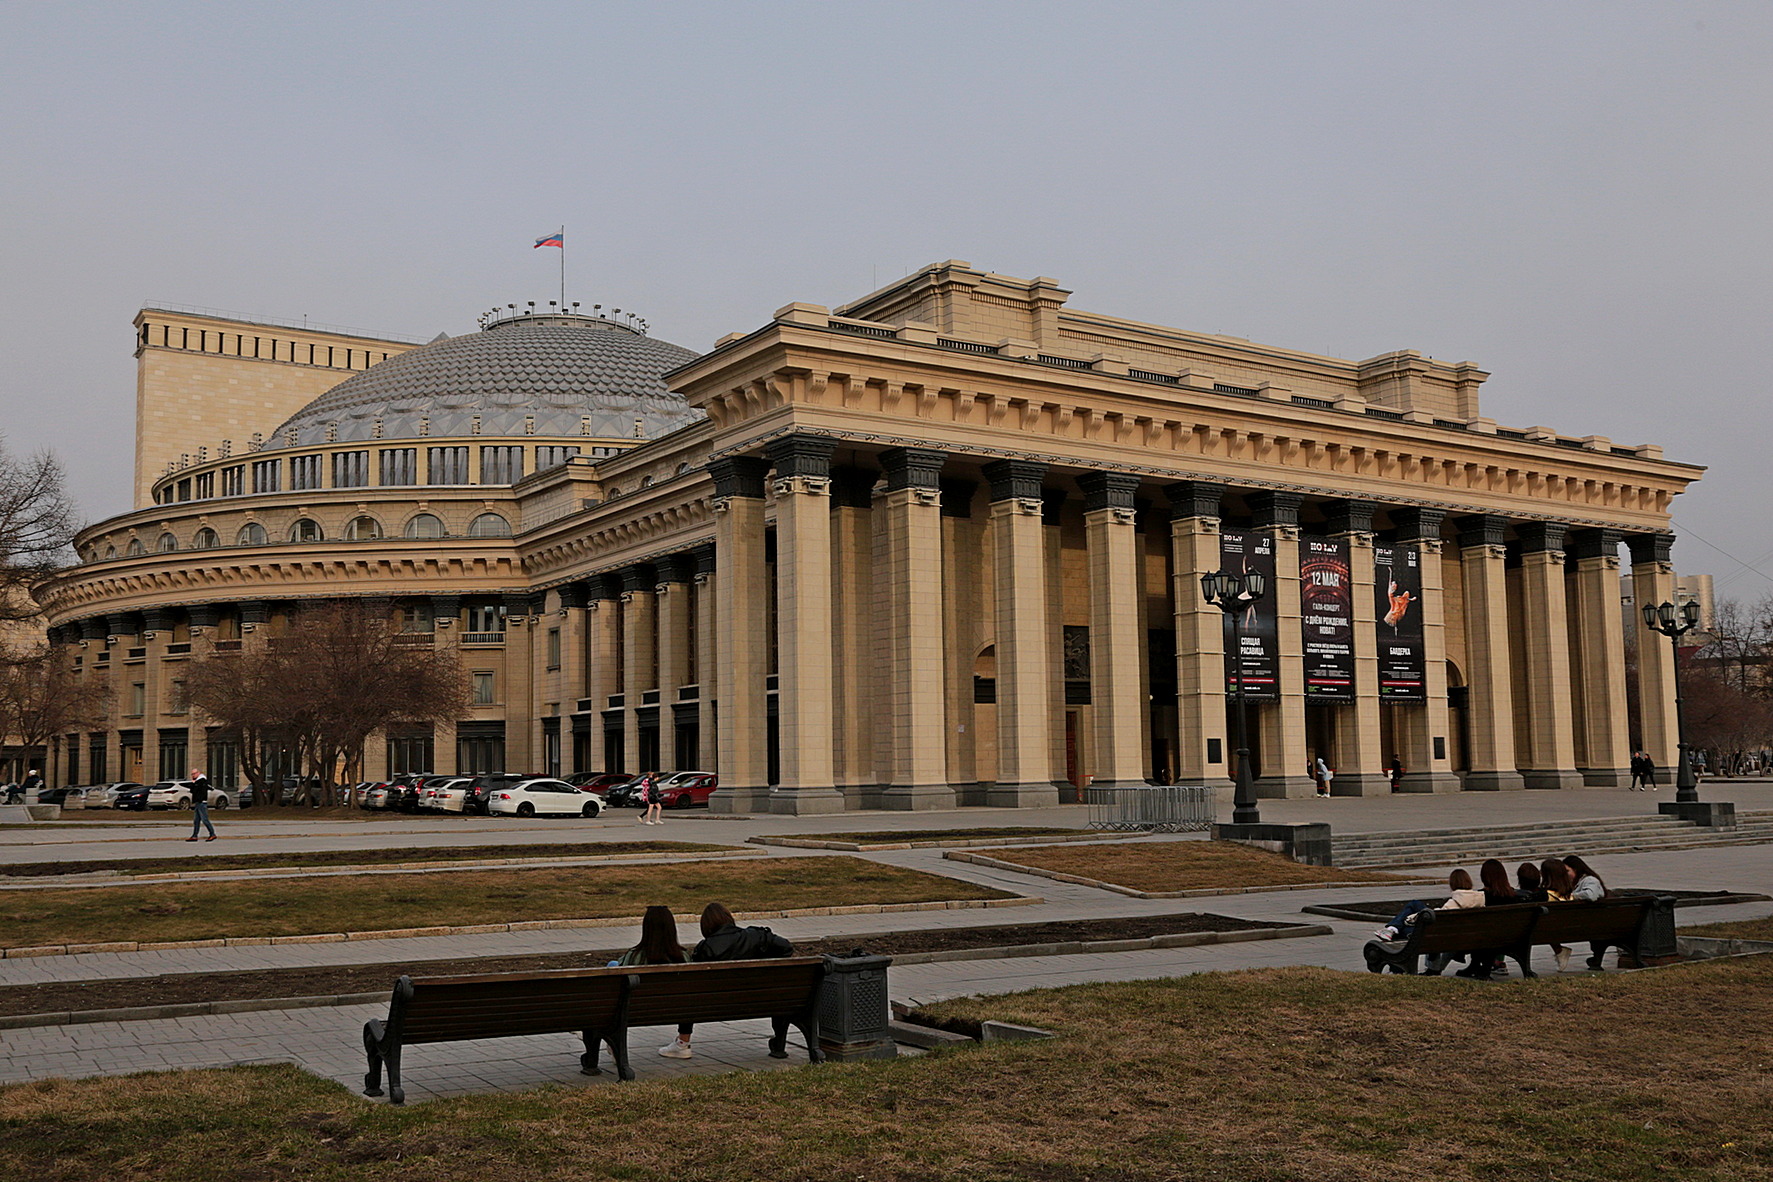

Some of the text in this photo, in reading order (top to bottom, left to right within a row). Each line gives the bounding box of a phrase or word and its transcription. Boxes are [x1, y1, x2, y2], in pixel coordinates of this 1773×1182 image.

[1262, 538, 1270, 547] 27
[1254, 547, 1270, 555] АПРЕЛЯ
[1312, 571, 1340, 587] 12 МАЯ
[1241, 637, 1260, 646] СПЯЩАЯ
[1240, 646, 1264, 656] РАСАВИЦА
[1389, 647, 1411, 656] БАЯДЕРКА
